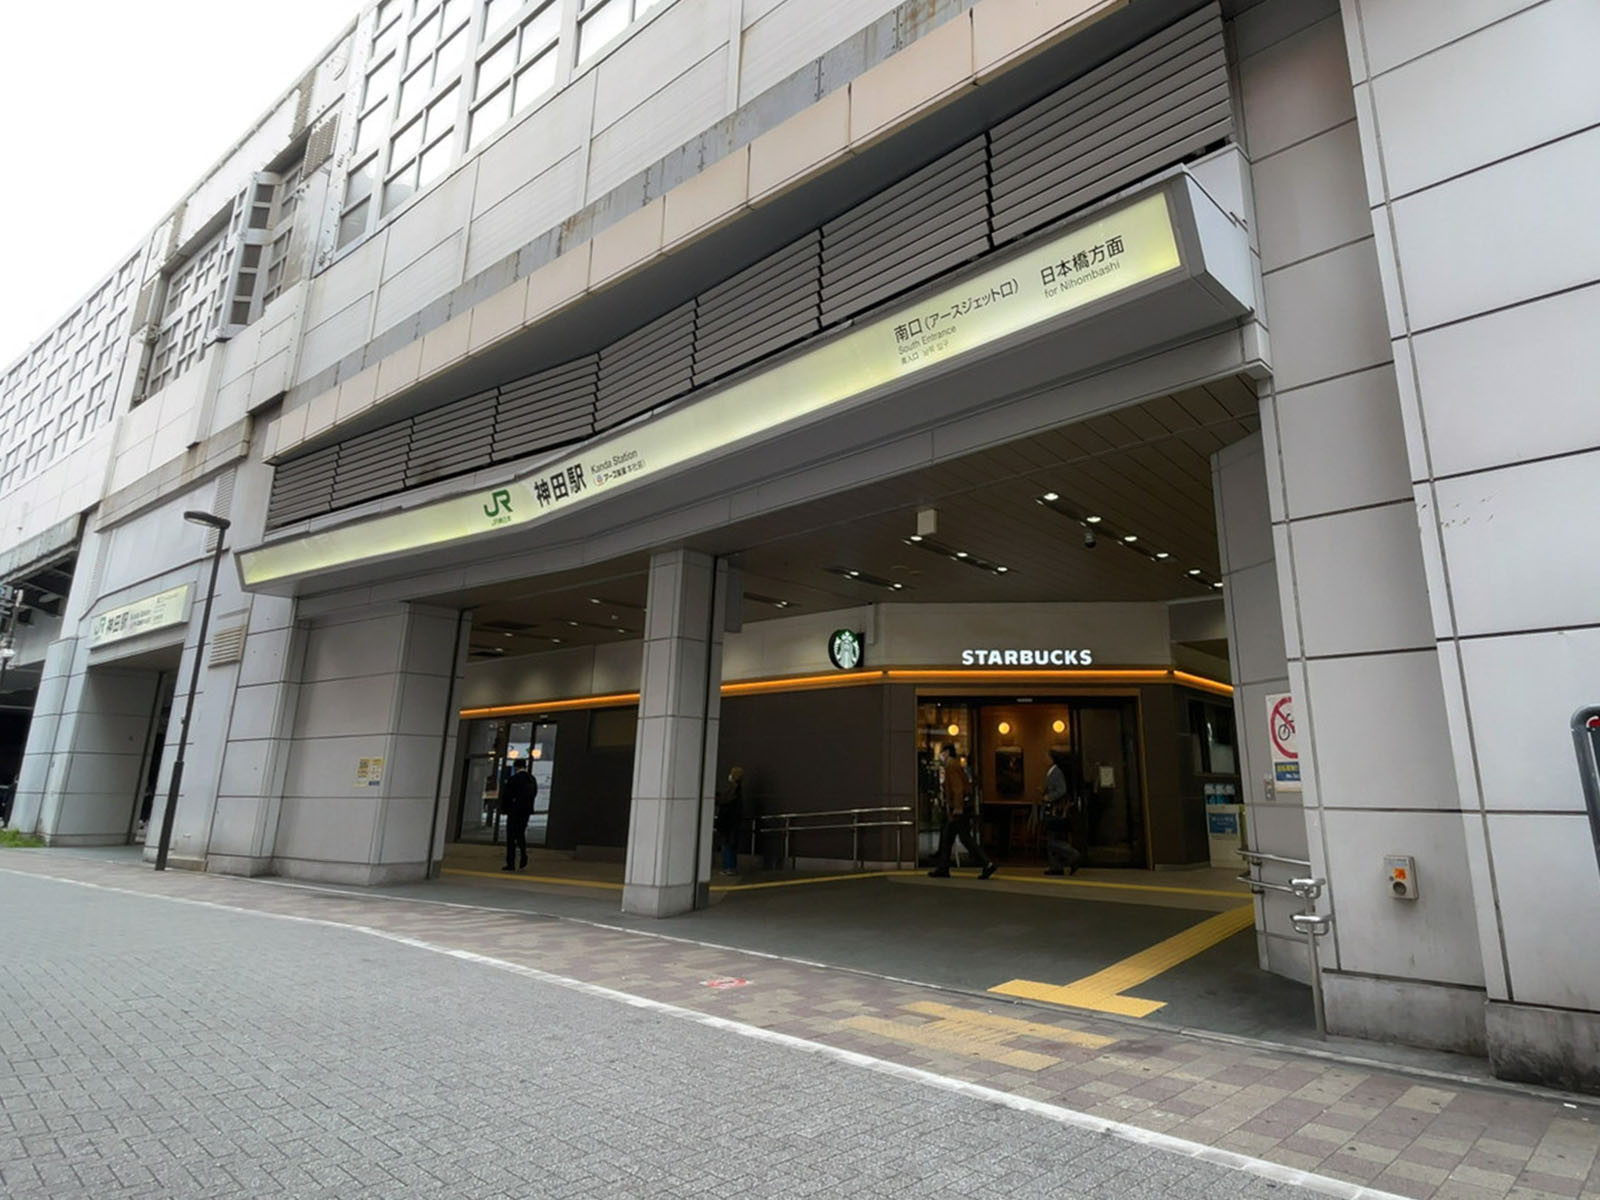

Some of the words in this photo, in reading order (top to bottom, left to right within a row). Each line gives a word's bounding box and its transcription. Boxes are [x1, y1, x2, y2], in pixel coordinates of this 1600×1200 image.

[1041, 236, 1124, 286] 日本橋方面
[1045, 287, 1058, 299] for
[1060, 262, 1121, 293] Nihombashi
[921, 326, 957, 345] Entrance
[591, 461, 612, 473] Kanda
[612, 450, 638, 466] Station
[534, 463, 588, 508] 神田駅
[483, 489, 513, 517] JR
[961, 649, 1093, 666] STARBUCKS
